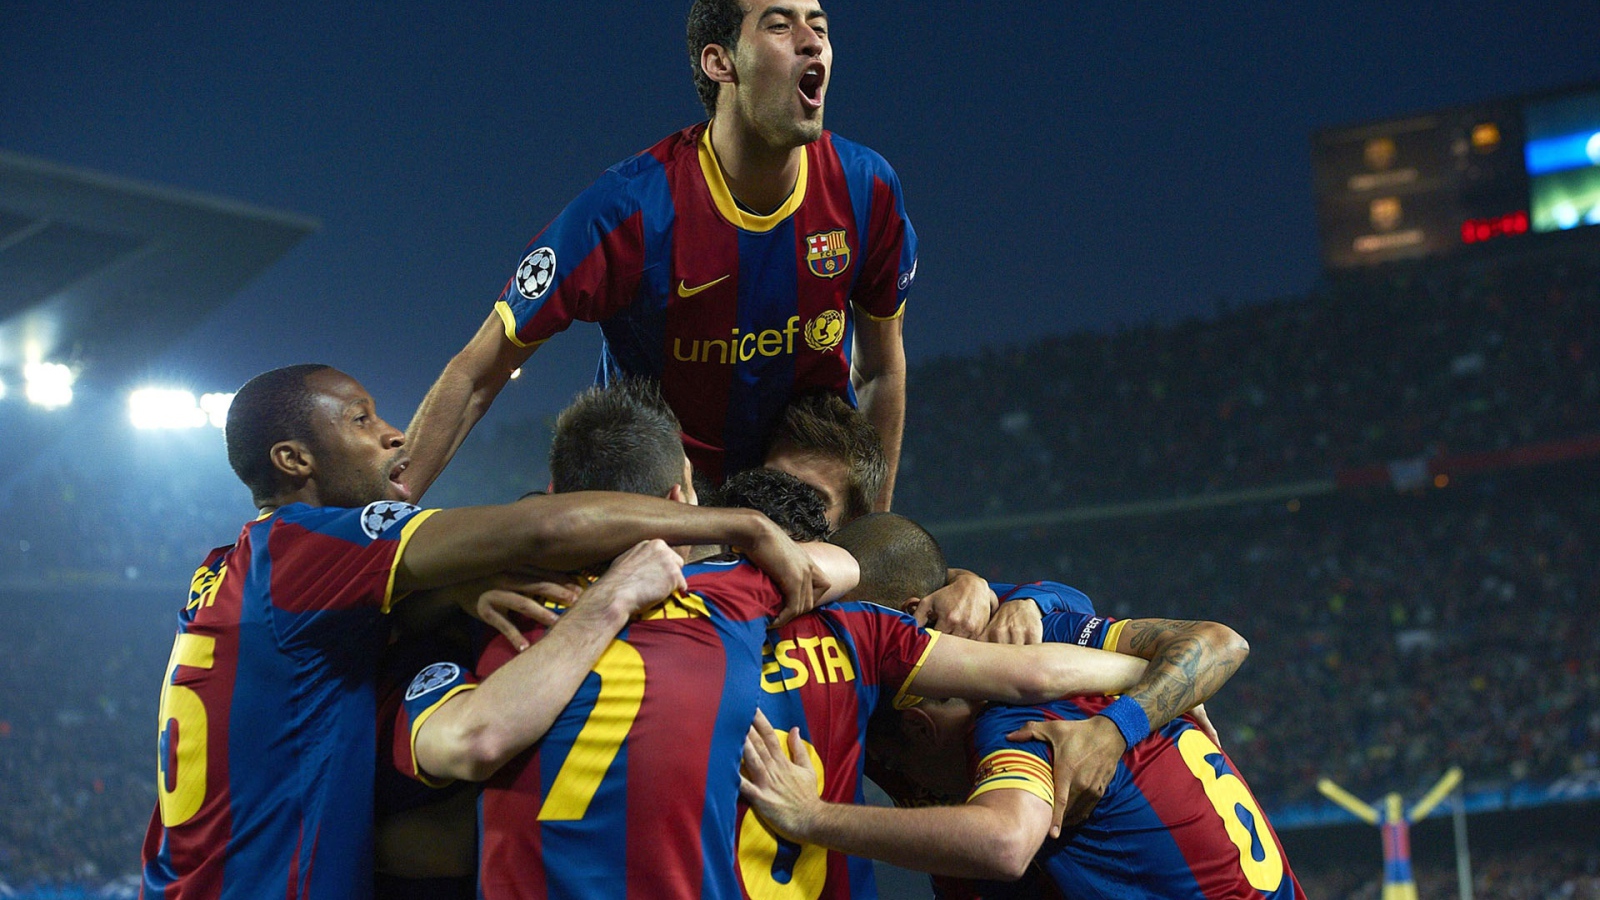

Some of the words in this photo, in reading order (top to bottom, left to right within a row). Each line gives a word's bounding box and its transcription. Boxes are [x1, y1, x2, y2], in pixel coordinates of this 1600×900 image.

[673, 315, 800, 364] unicef
[1078, 617, 1103, 646] ESPECT
[158, 632, 216, 828] 5
[1177, 728, 1283, 892] 6
